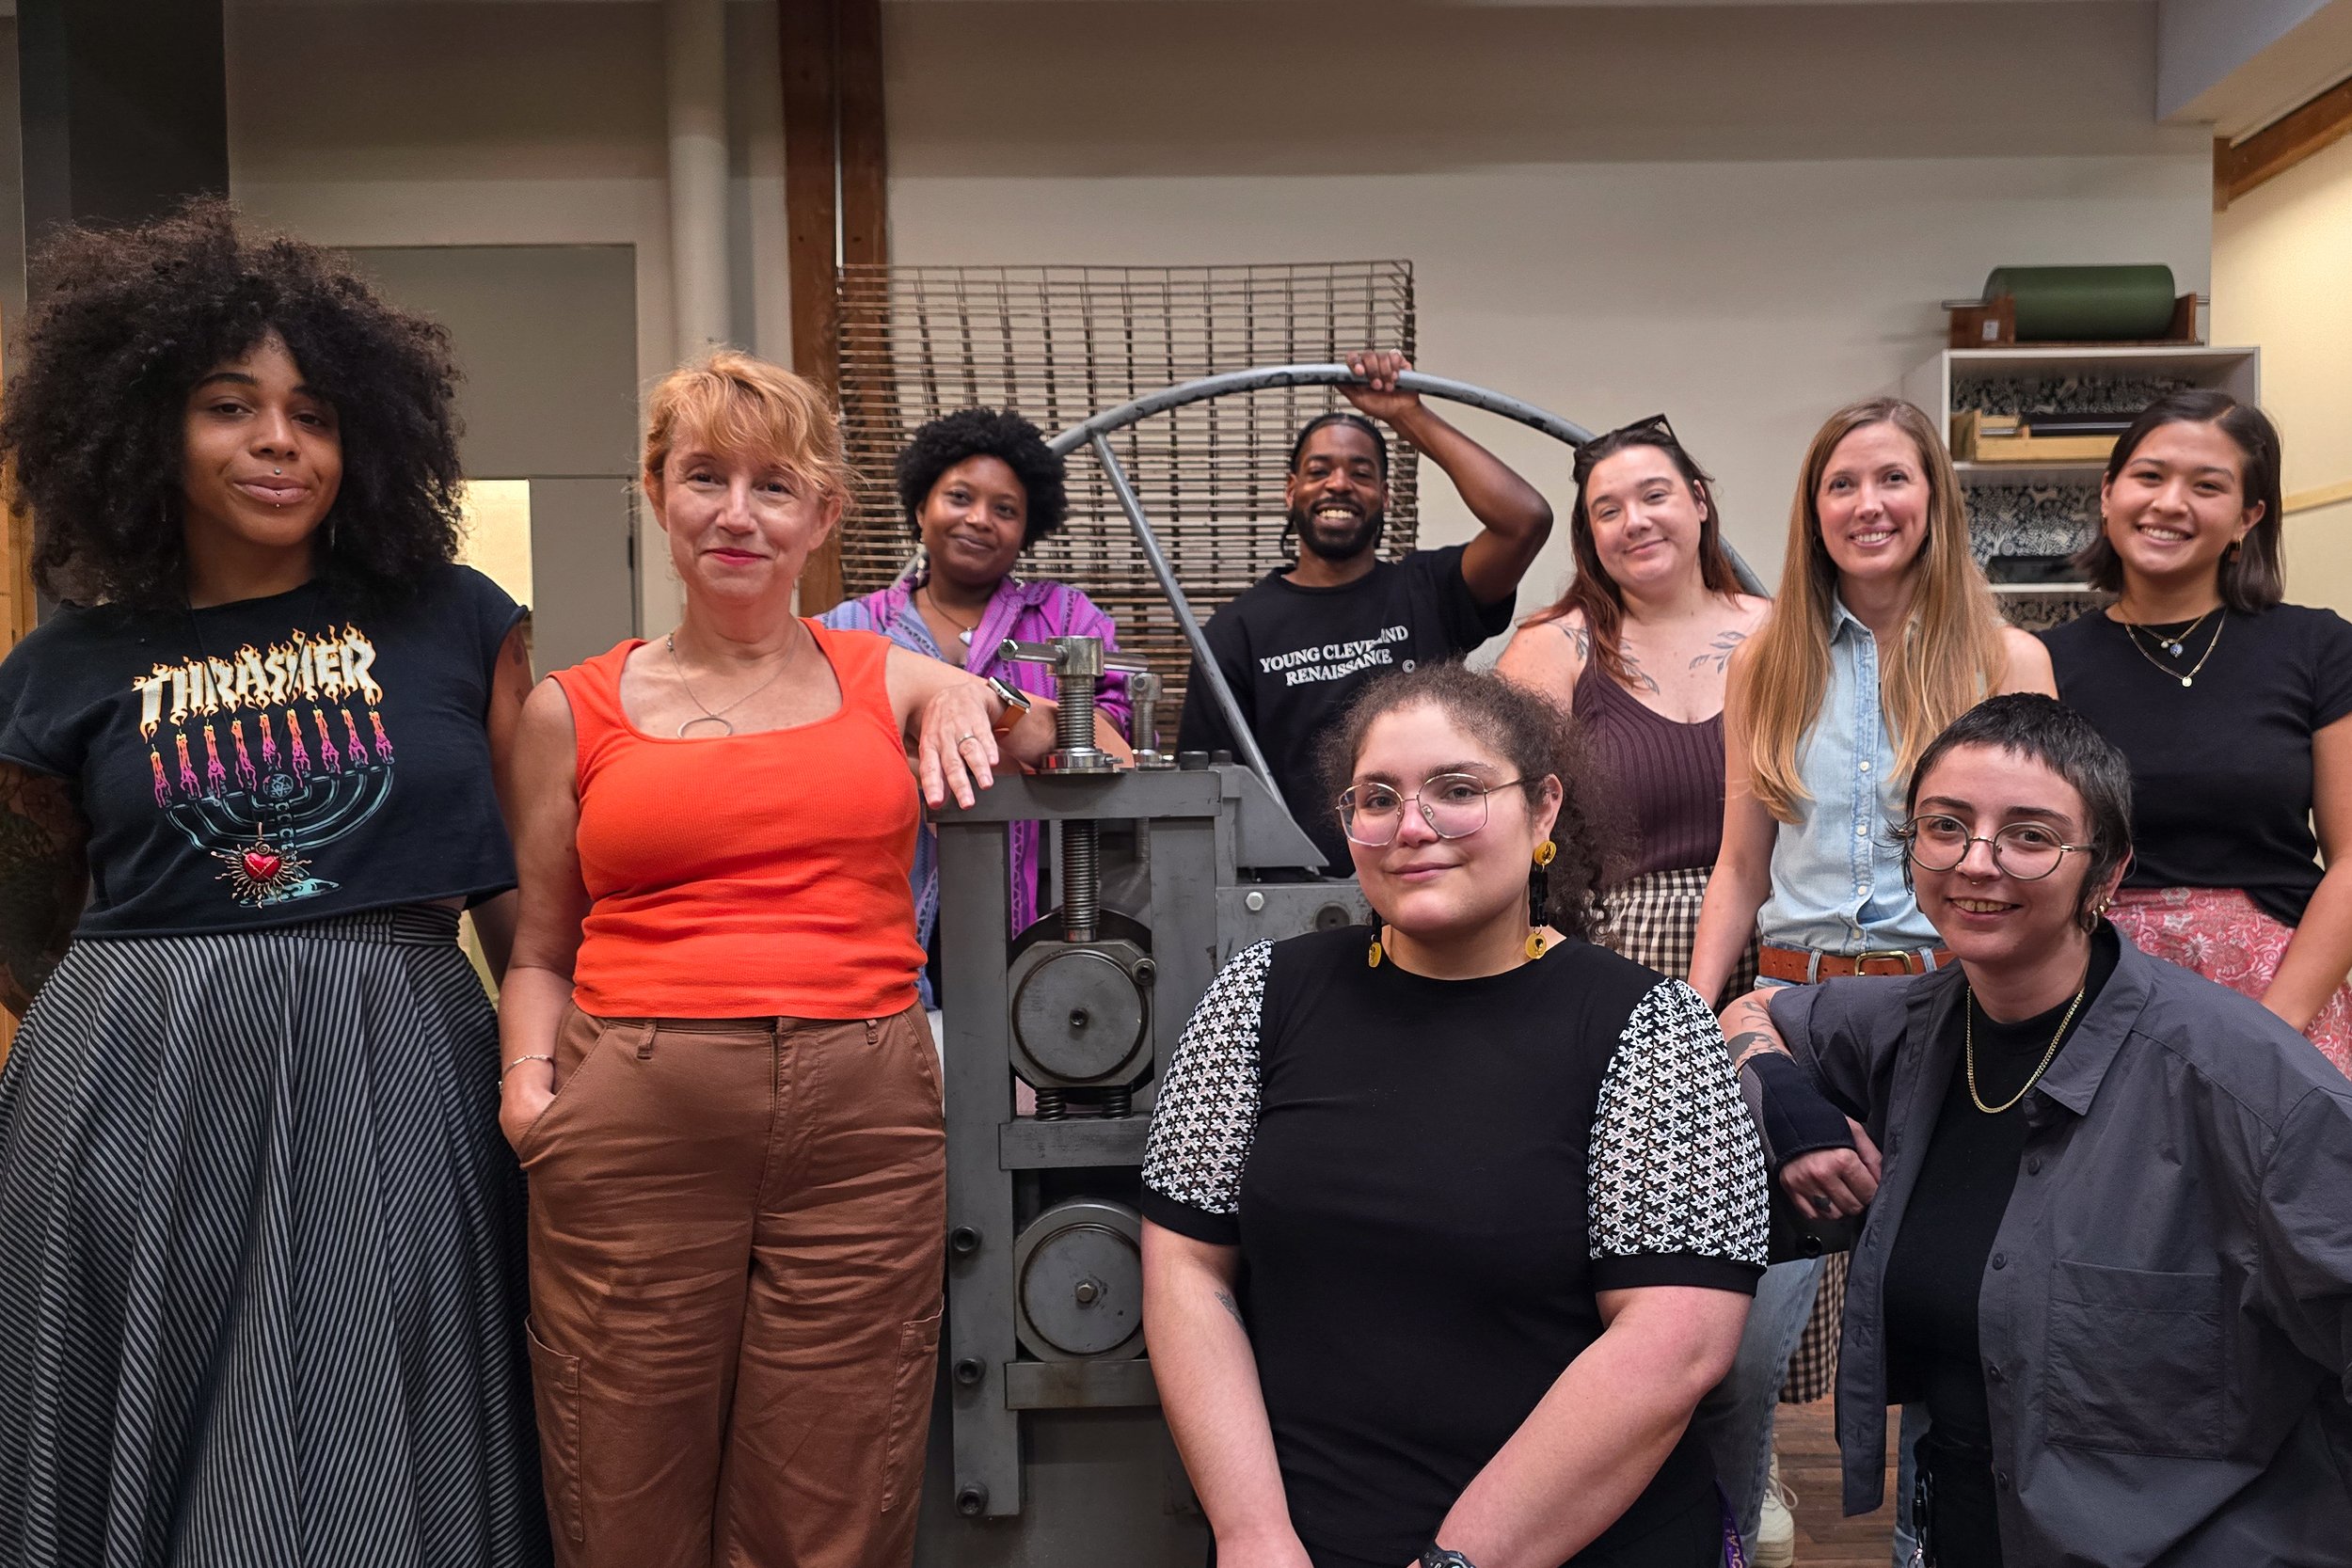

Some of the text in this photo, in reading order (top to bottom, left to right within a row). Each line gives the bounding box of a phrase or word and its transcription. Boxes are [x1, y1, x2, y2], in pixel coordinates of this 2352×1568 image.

[1259, 645, 1321, 673] YOUNG
[1284, 648, 1393, 687] RENAISSANCE
[132, 624, 383, 741] THRASHER
